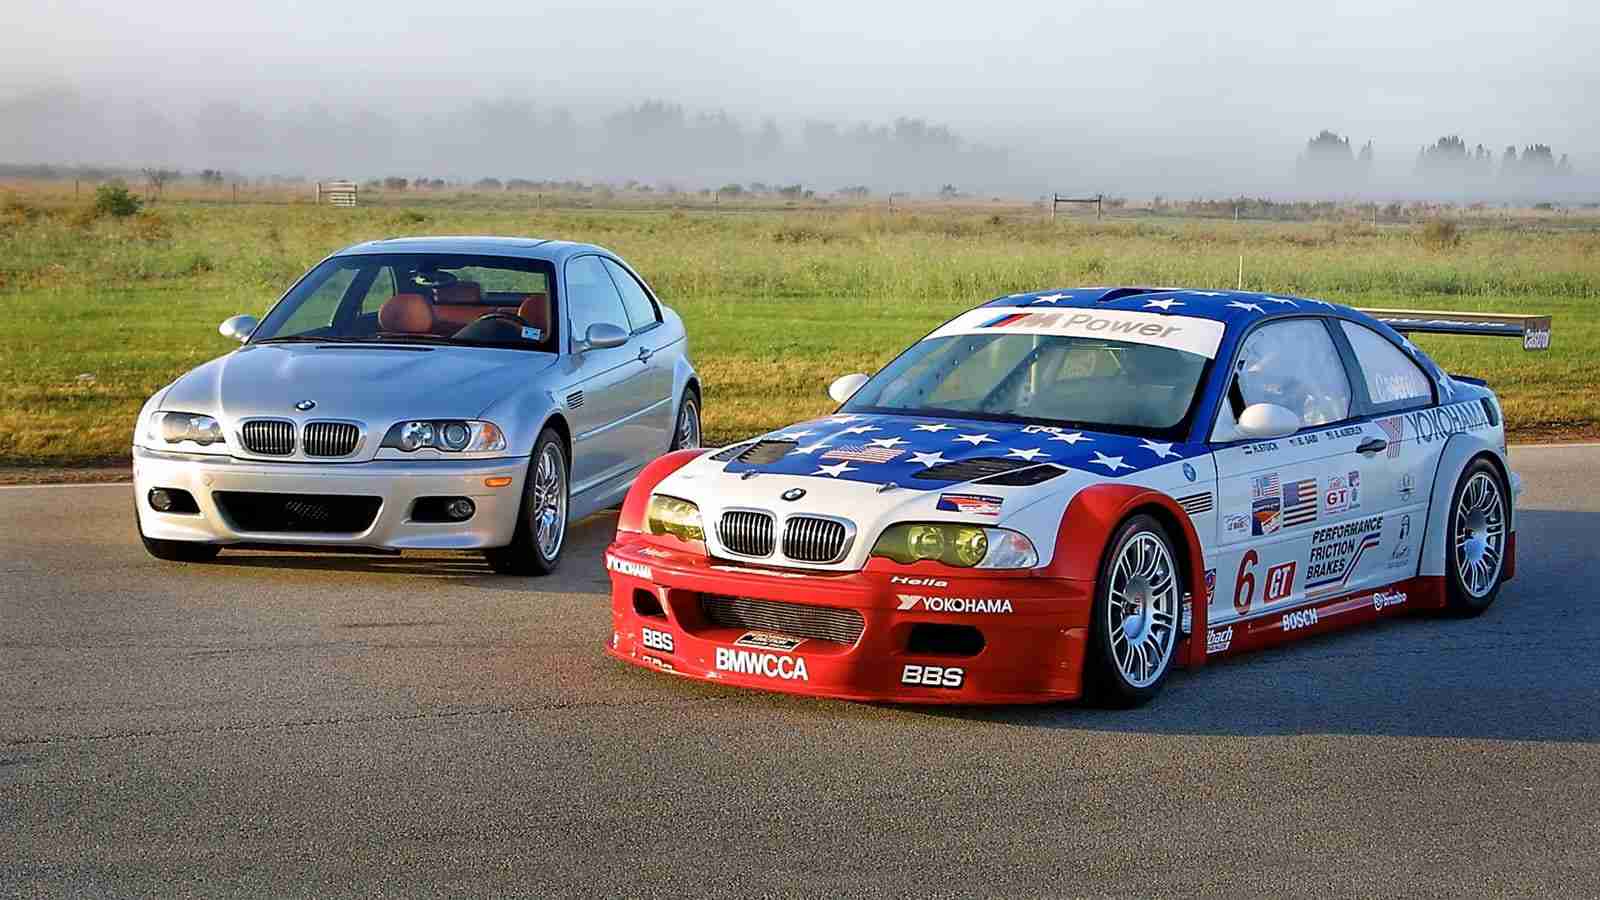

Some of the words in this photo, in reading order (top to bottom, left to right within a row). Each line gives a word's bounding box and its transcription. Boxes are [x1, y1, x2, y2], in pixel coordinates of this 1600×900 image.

[1060, 313, 1181, 338] Power
[1523, 329, 1550, 349] Castrol
[1405, 398, 1488, 444] YOKOHAMA
[1326, 490, 1346, 506] GT
[1311, 517, 1383, 543] PERFORMANCE
[1309, 541, 1355, 563] FRICTION
[1233, 548, 1258, 615] 6
[1306, 560, 1346, 579] BRAKES
[890, 576, 949, 588] Hella
[1269, 568, 1291, 600] GT
[922, 597, 1013, 613] YOKOHAMA
[1281, 608, 1319, 632] BOSCH
[643, 628, 673, 652] BBS
[715, 647, 809, 681] BMWCCA
[901, 664, 964, 687] BBS
